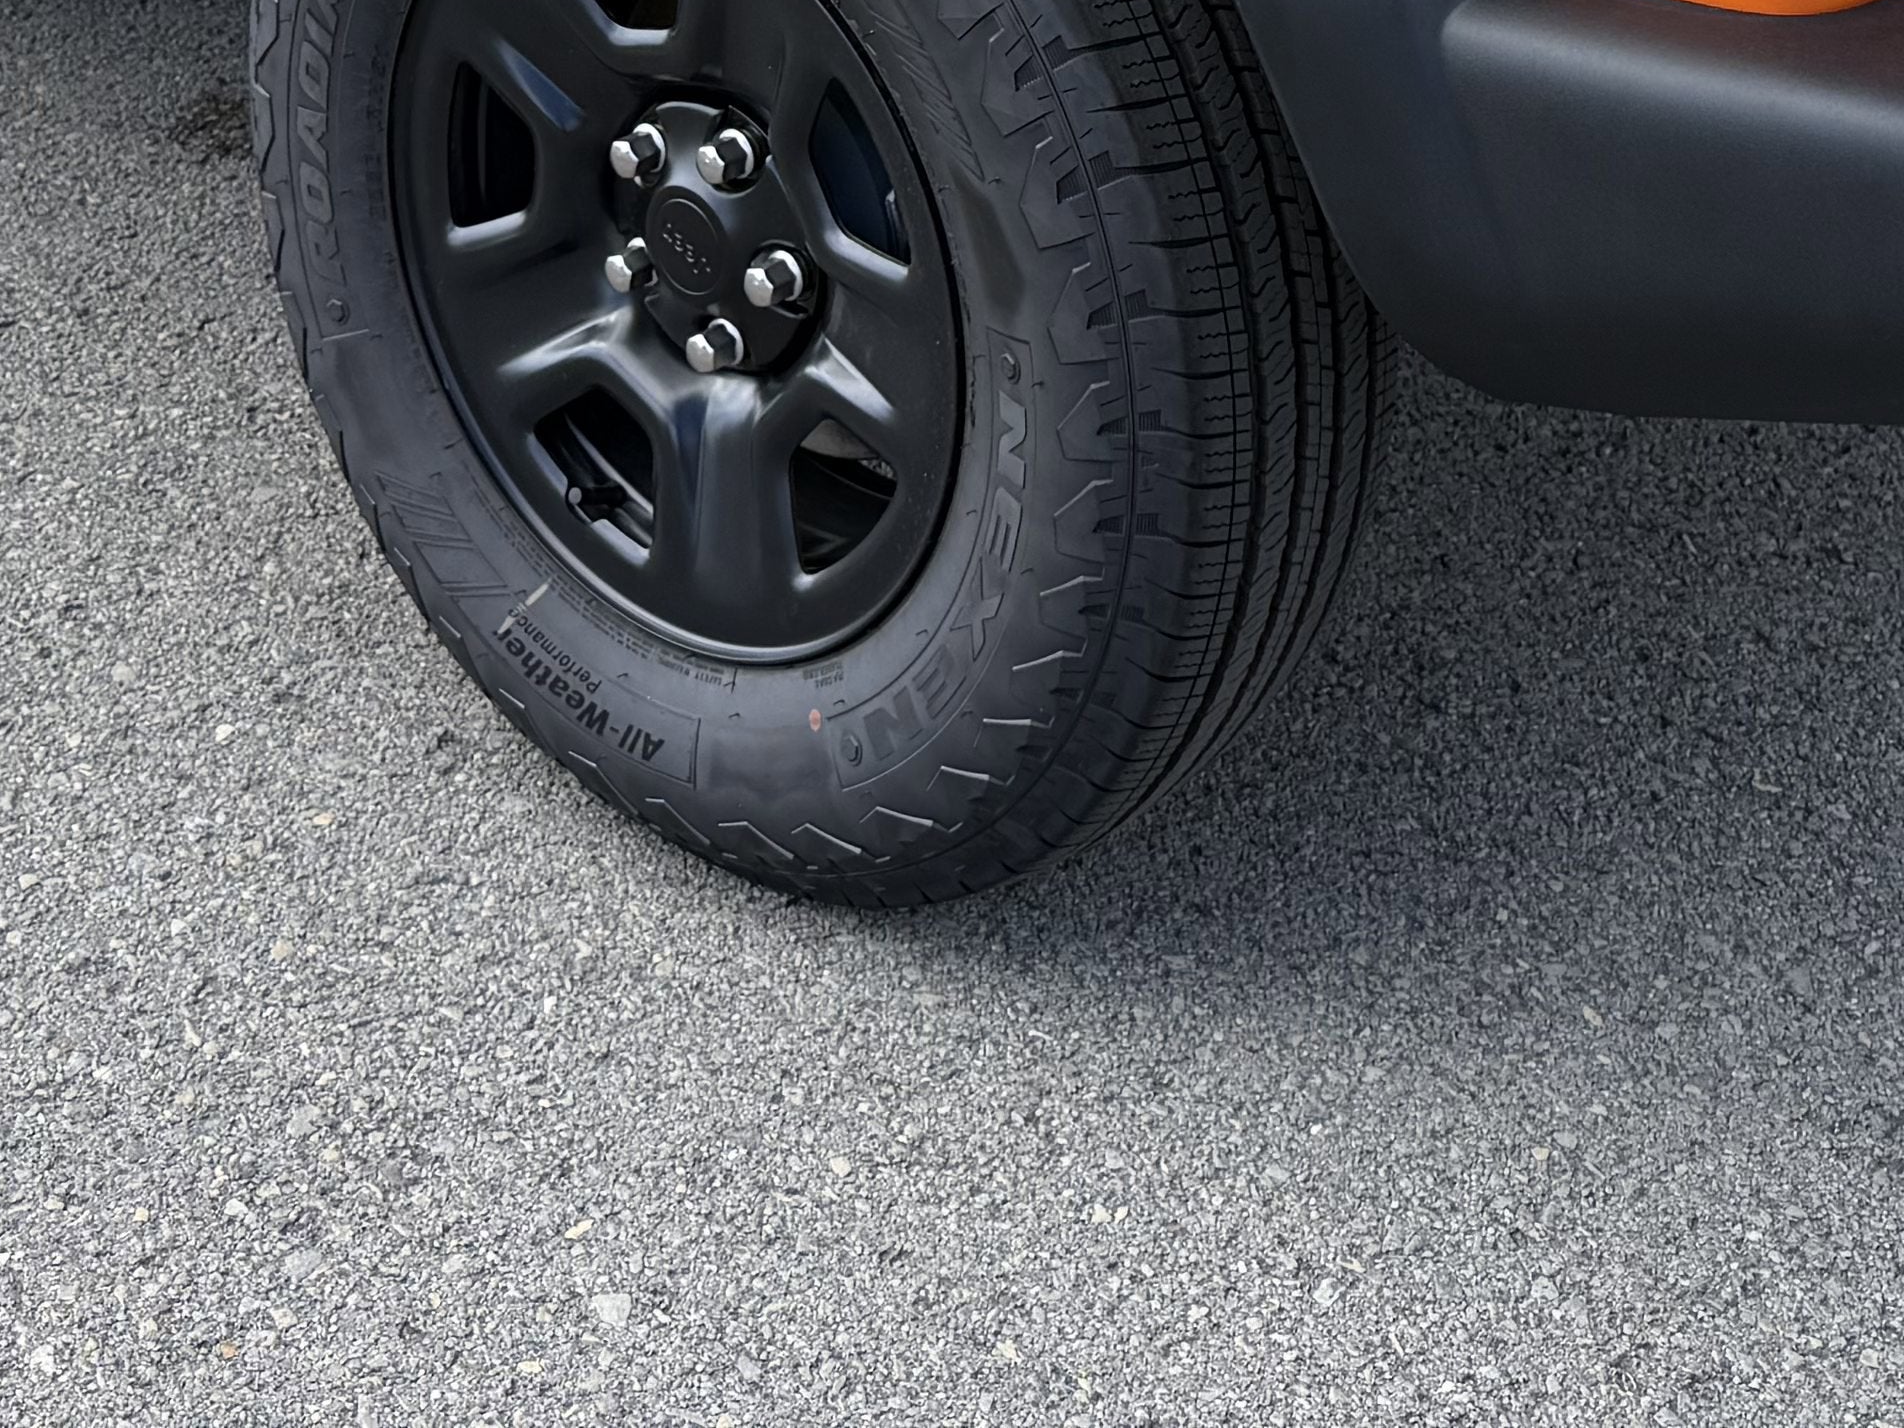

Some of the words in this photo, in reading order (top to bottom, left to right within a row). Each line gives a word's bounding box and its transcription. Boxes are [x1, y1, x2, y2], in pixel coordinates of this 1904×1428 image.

[864, 384, 1032, 758] NEXEN
[493, 628, 666, 763] All-Weather
[506, 608, 604, 694] Performance
